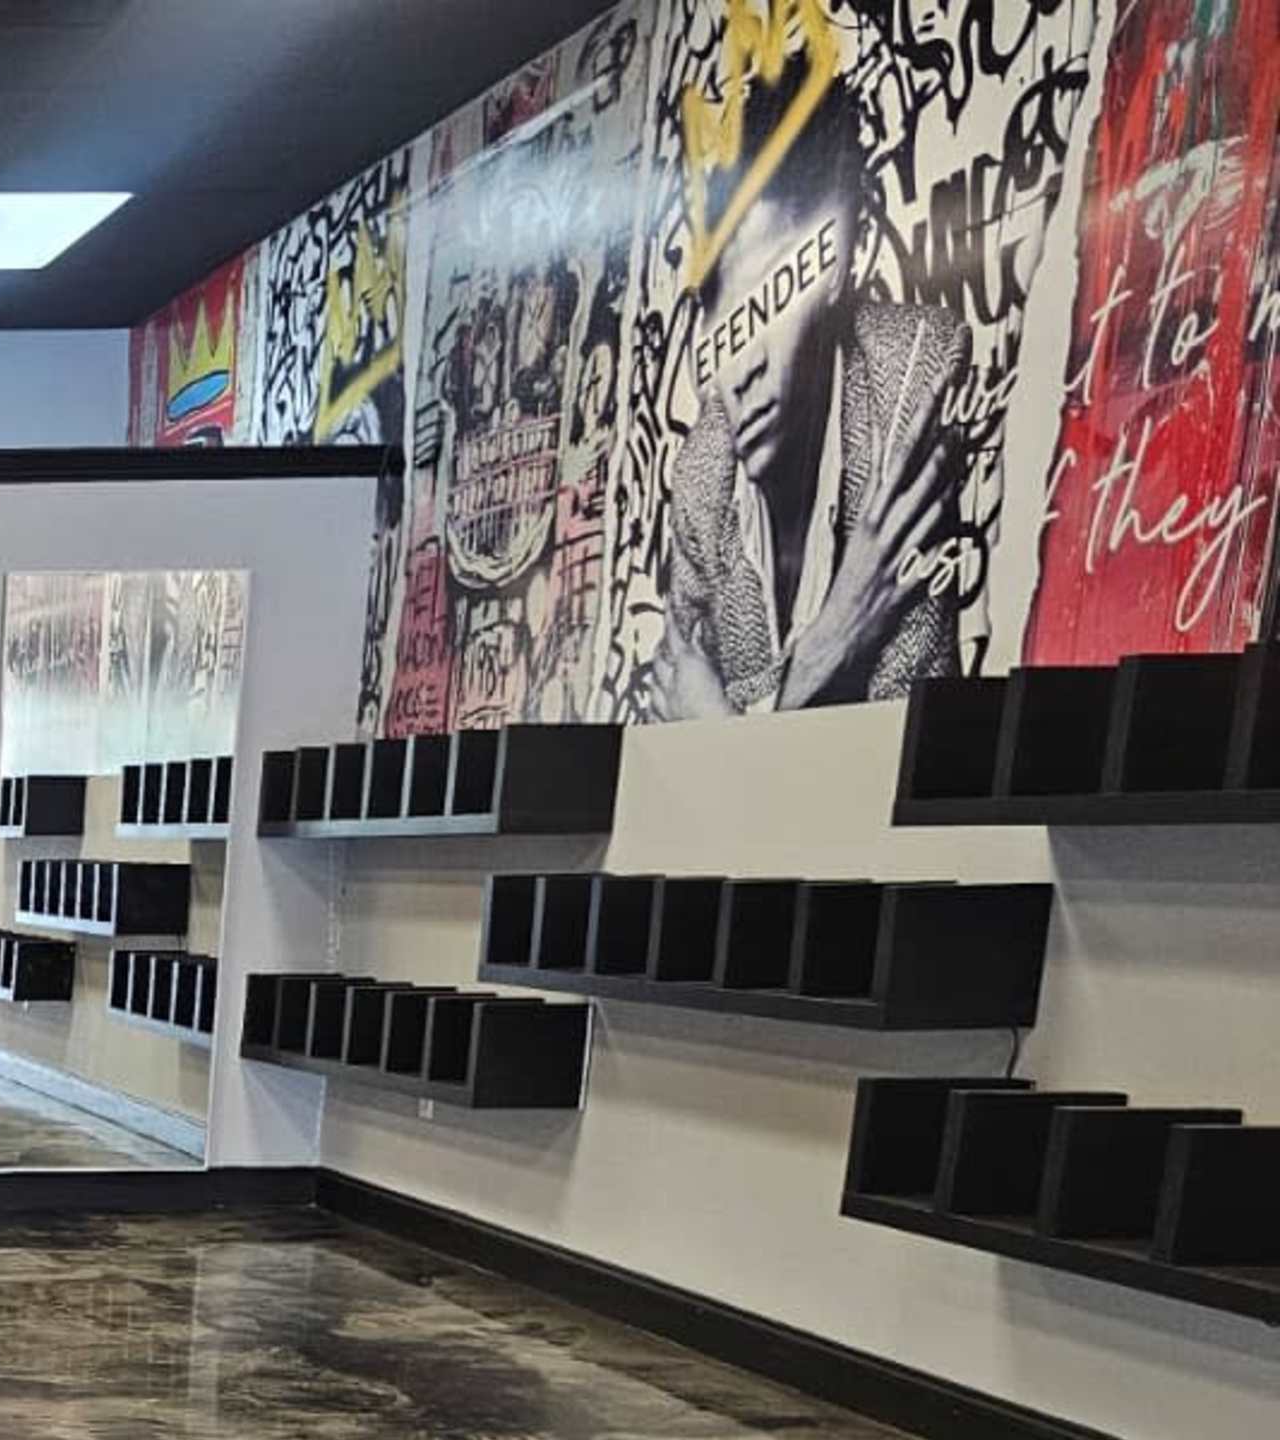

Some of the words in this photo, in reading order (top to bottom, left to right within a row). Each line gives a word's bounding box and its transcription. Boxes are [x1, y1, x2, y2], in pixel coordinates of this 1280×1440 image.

[695, 218, 838, 388] EFENDEE
[1145, 244, 1221, 391] to
[1083, 415, 1269, 633] they
